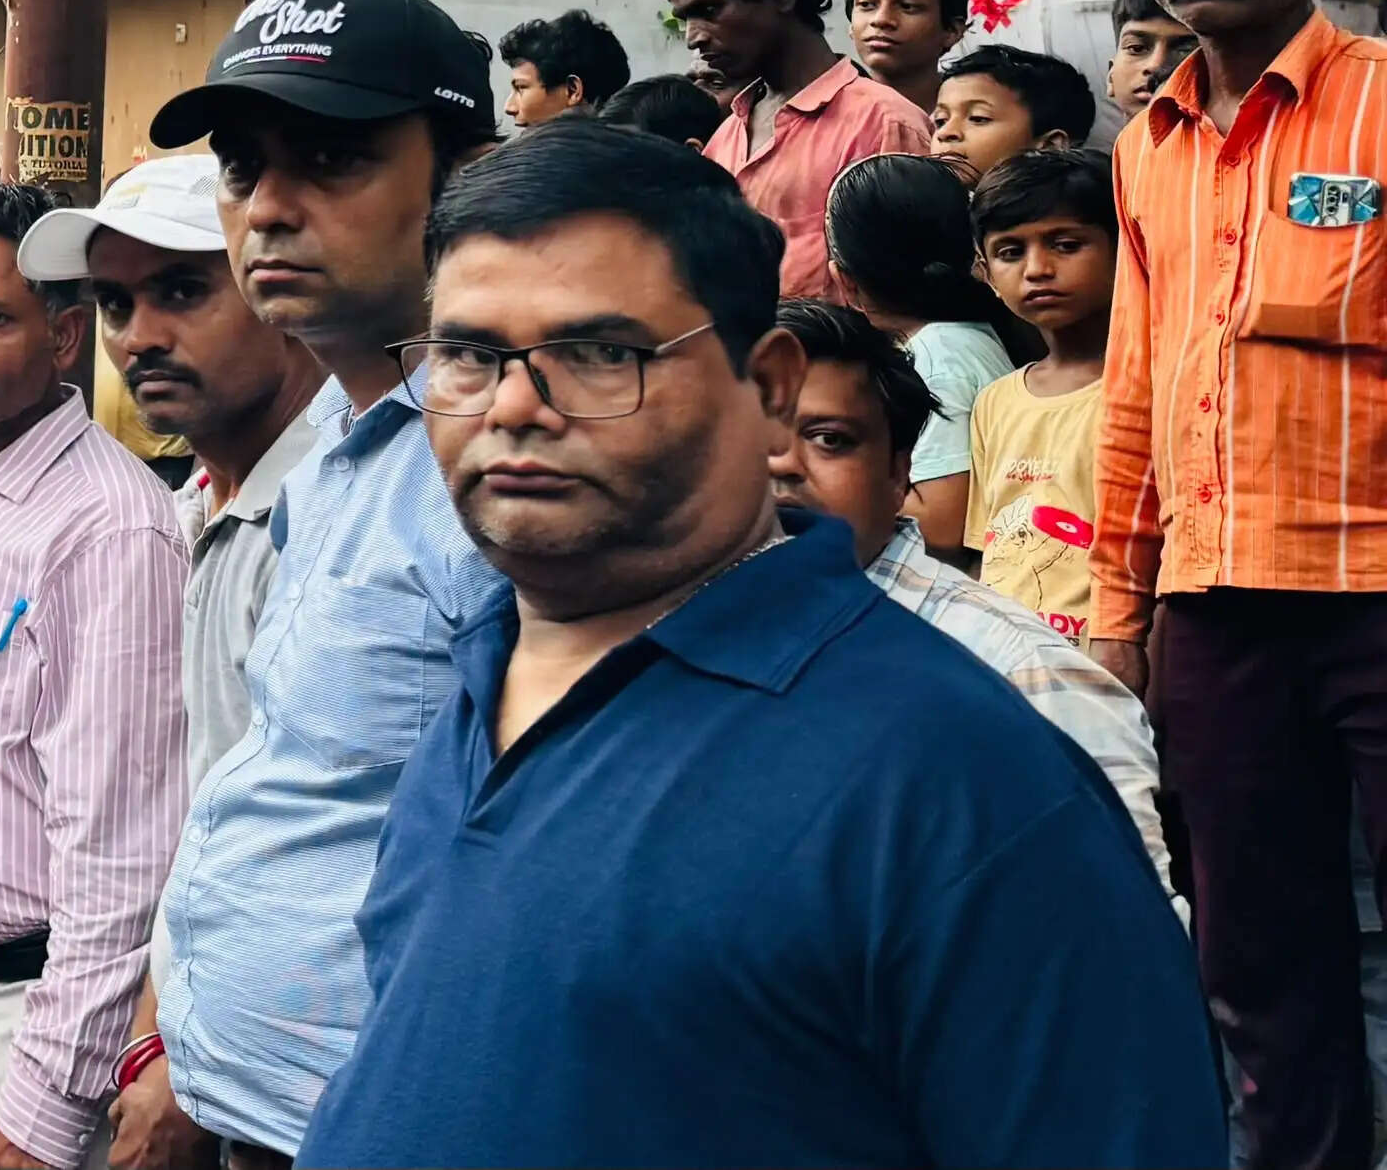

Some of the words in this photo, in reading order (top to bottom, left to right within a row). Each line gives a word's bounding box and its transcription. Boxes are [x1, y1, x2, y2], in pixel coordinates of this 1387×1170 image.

[262, 43, 332, 56] EVERYTHING
[434, 86, 475, 109] LOTTO
[15, 106, 90, 130] OME
[1035, 611, 1088, 637] DY
